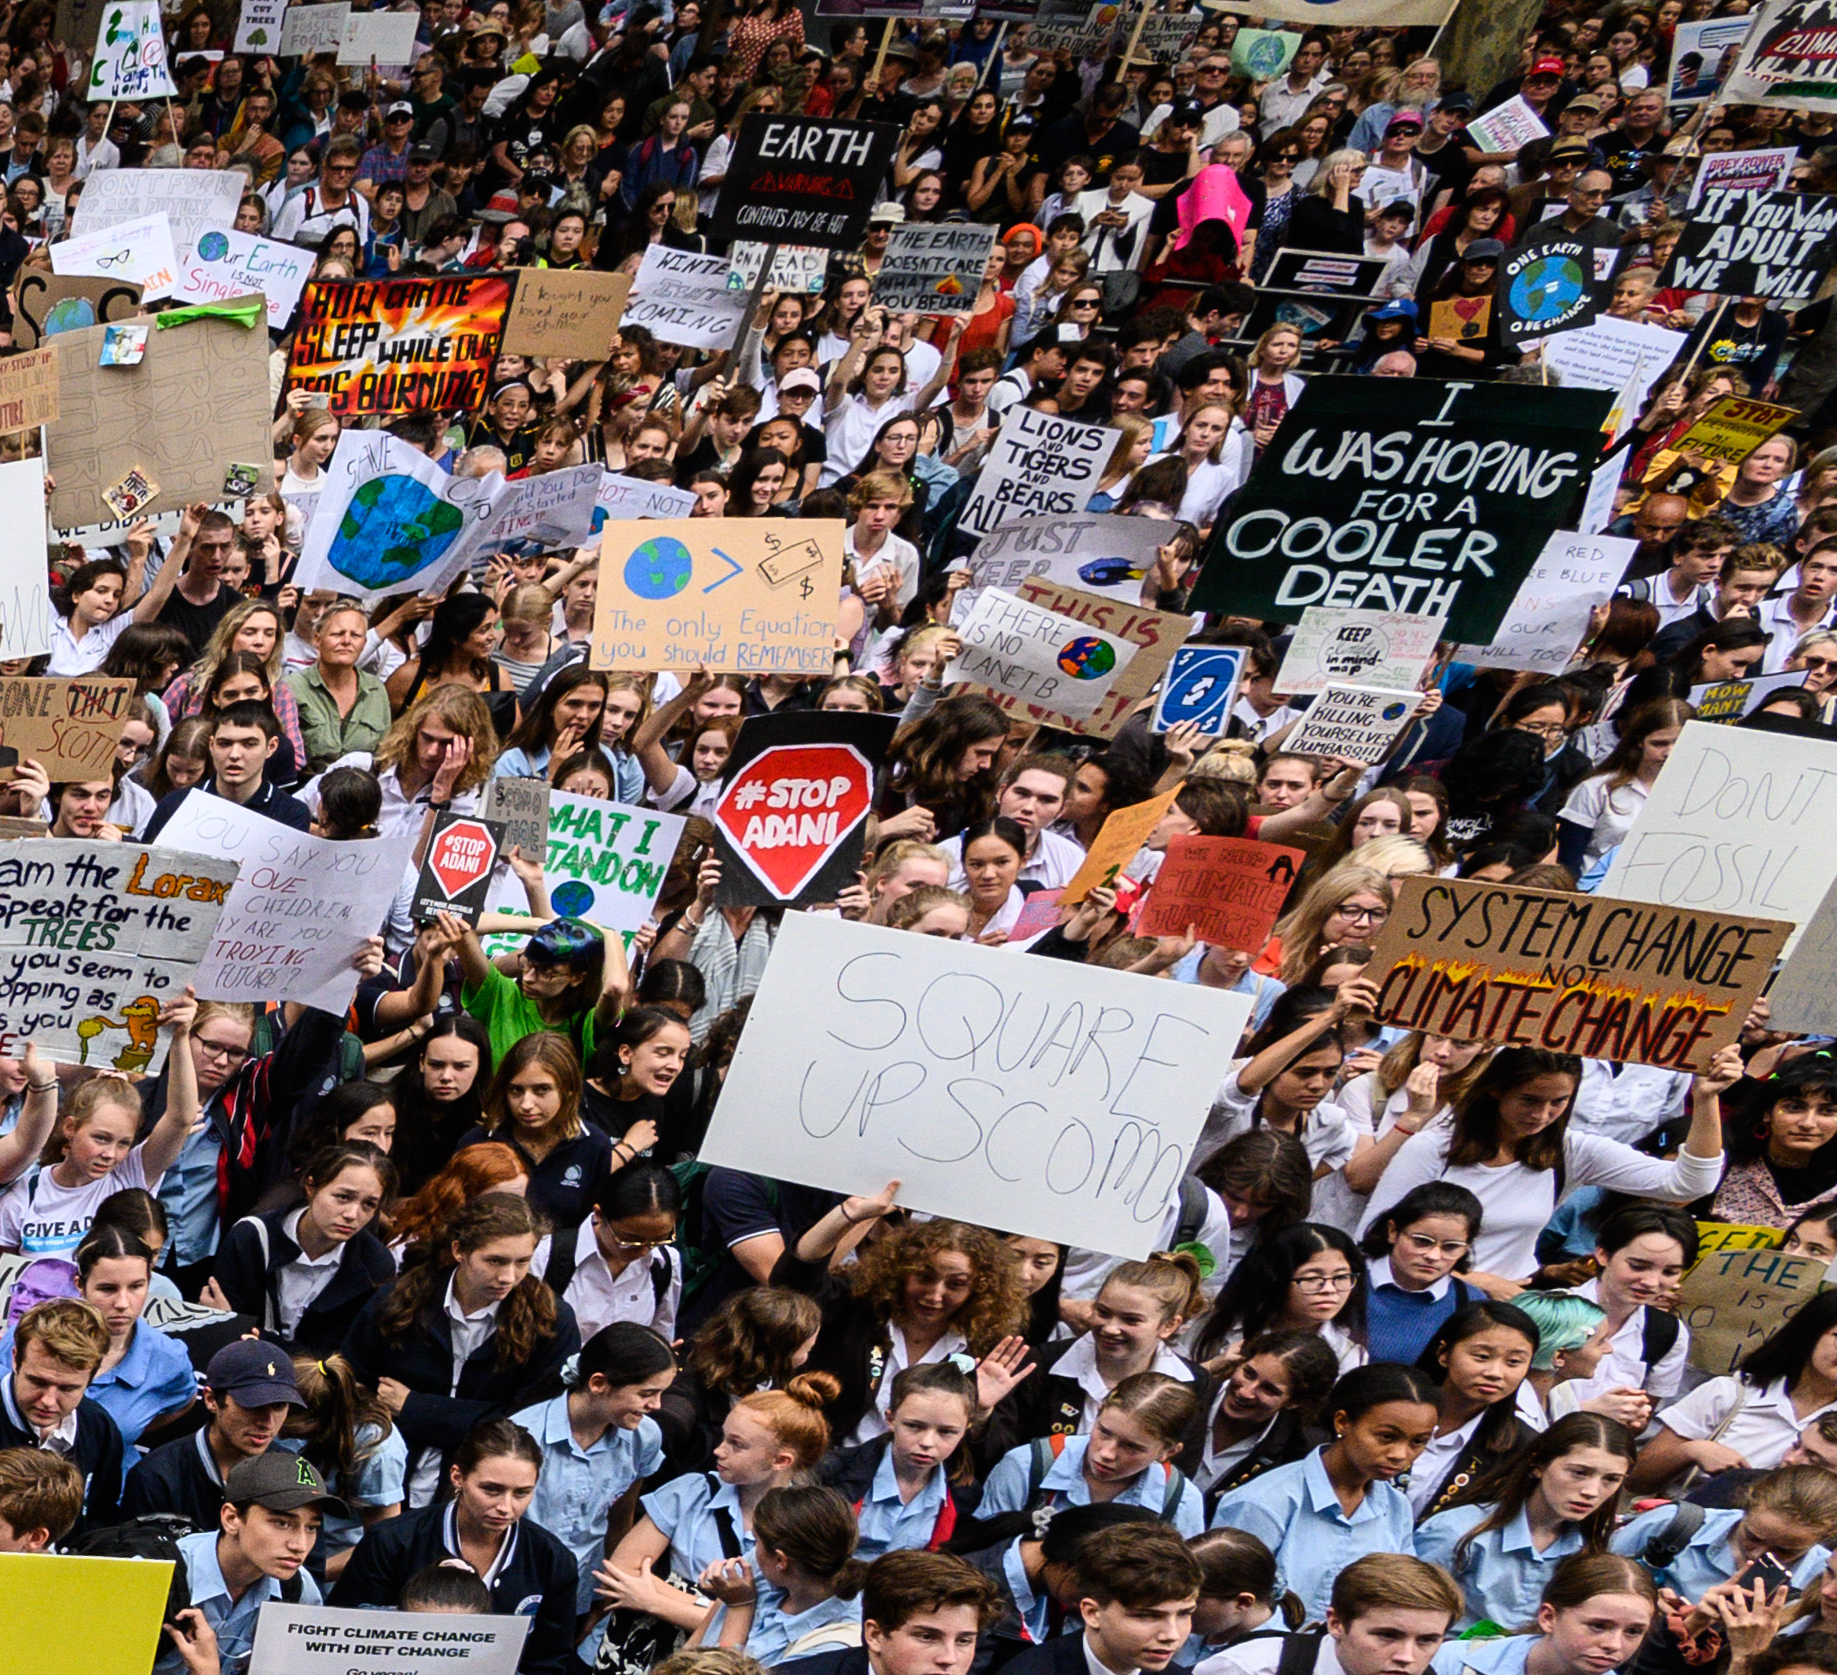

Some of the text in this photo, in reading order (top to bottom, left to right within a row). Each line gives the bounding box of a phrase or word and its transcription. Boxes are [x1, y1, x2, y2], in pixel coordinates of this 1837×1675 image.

[759, 124, 874, 166] EARTH
[736, 205, 849, 234] CONTENTS MAY BE HOT
[1418, 382, 1474, 427] I
[1020, 417, 1103, 450] LIONS
[1040, 440, 1063, 452] AND
[1006, 440, 1092, 481] TIGERS
[1282, 428, 1579, 499] WAS HOPING
[1025, 470, 1050, 486] AND
[1351, 491, 1479, 524] FOR A
[1226, 510, 1499, 578] COOLER
[1276, 565, 1462, 617] DEATH
[609, 608, 835, 644] The only Equation
[600, 639, 834, 669] you should REMEMBER
[1325, 689, 1375, 710] YOU'RE
[1312, 707, 1377, 728] KILLING
[1301, 723, 1397, 747] YOURSELVES
[734, 776, 853, 811] #STOP
[741, 812, 839, 850] ADANI
[1406, 884, 1775, 990] SYSTEM CHANGE
[1542, 962, 1605, 989] NOT
[1373, 963, 1726, 1072] CLIMATE CHANGE
[288, 1623, 496, 1643] FIGHT CLIMATE CHANGE
[305, 1641, 470, 1658] WITH DIET CHANGE
